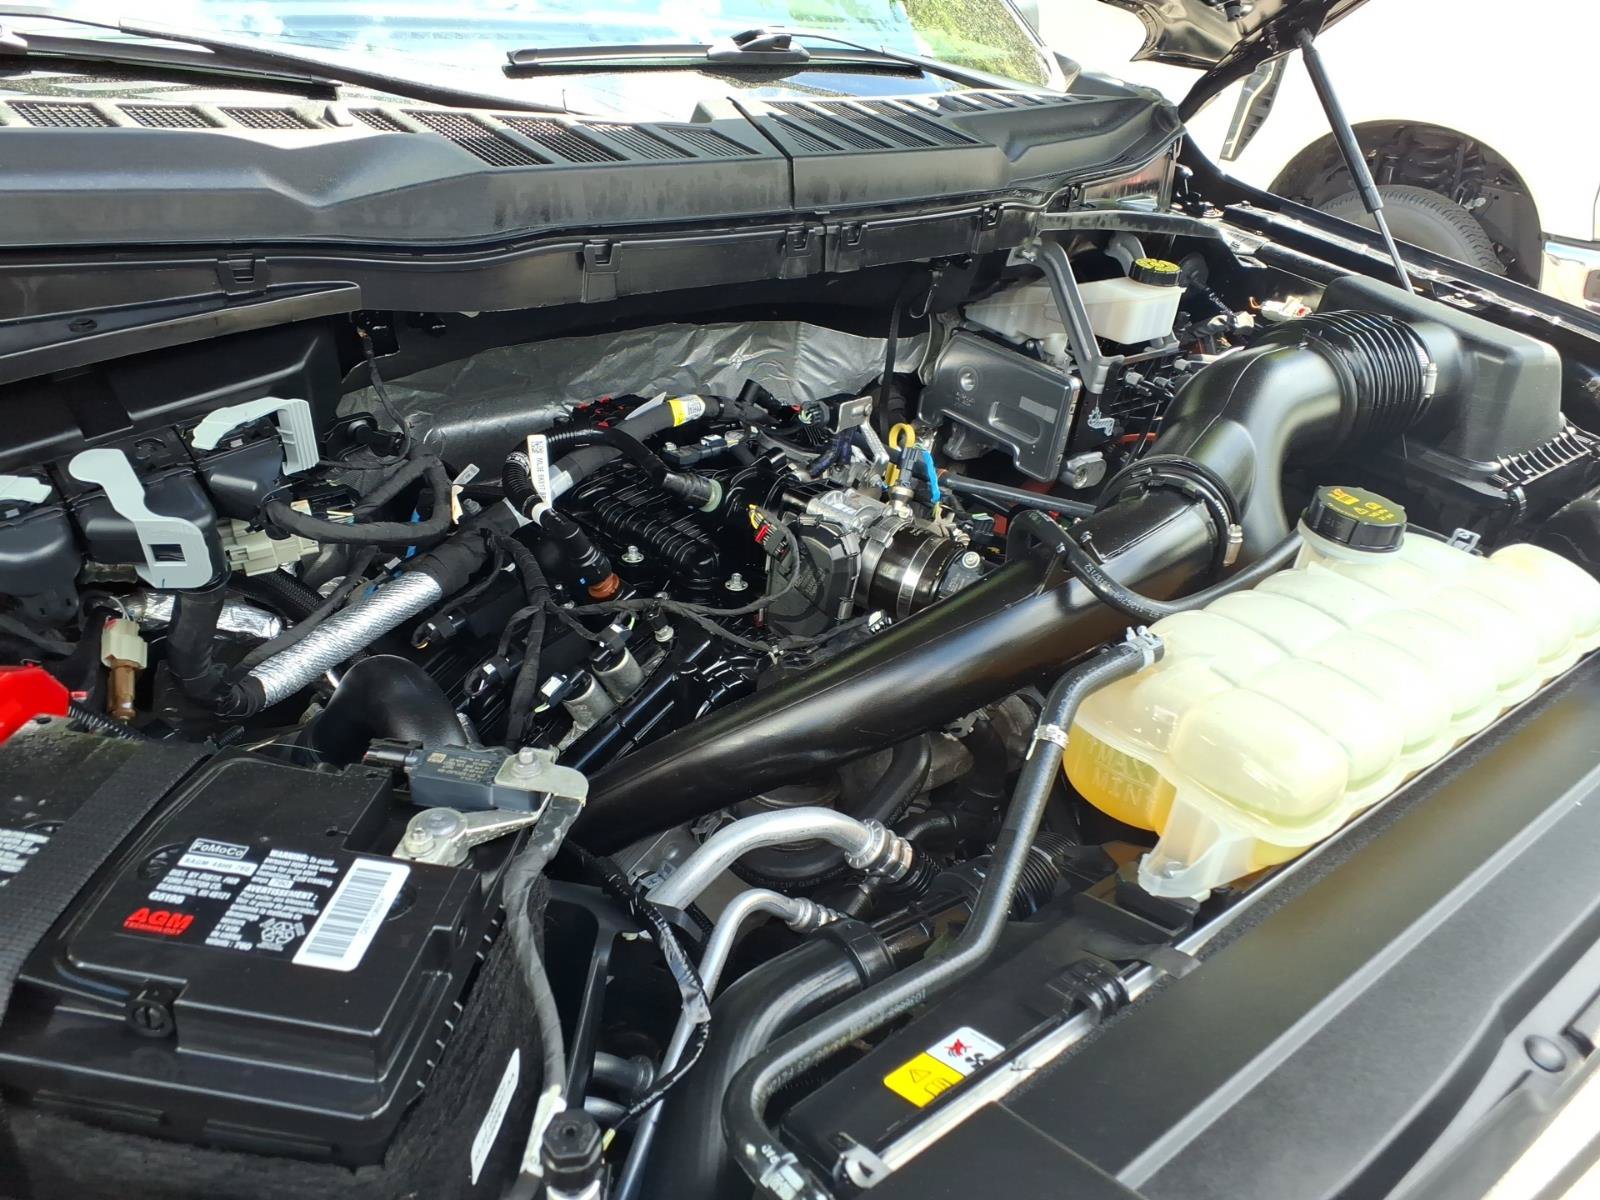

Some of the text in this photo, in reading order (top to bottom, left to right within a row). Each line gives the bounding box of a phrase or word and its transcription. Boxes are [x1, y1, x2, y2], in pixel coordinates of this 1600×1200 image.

[1096, 743, 1147, 782] MAX
[1091, 767, 1144, 806] MIN
[192, 841, 245, 857] FoMoCo
[126, 907, 195, 930] AGM
